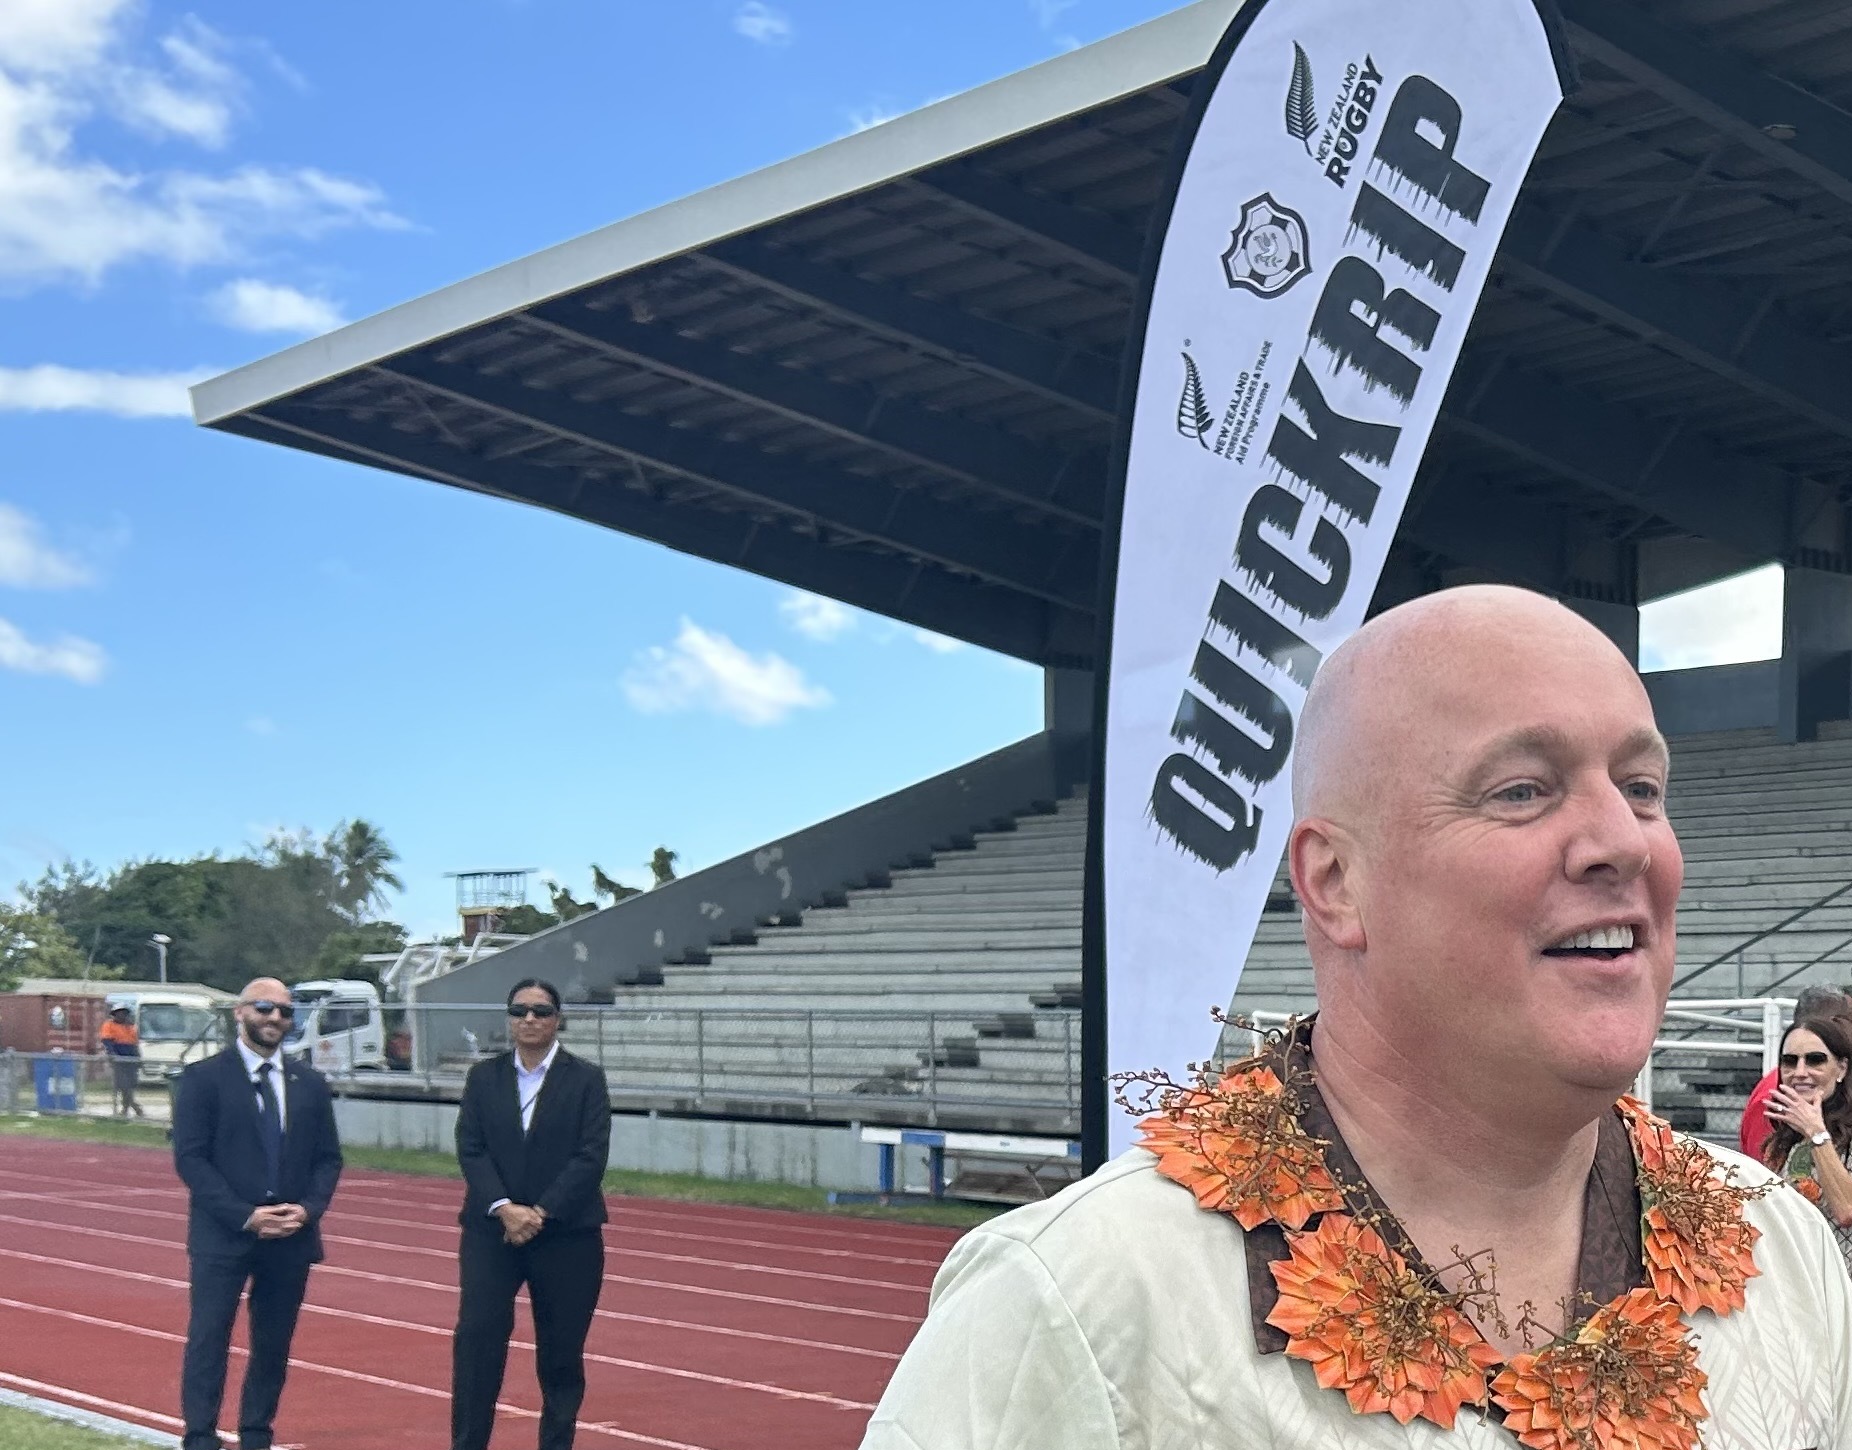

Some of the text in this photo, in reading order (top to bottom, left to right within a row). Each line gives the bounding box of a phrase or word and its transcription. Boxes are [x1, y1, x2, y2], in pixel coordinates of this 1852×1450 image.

[1315, 62, 1359, 167] NEW ZEALAND
[1324, 53, 1384, 190] RUGBY
[1213, 371, 1249, 455] NEW ZEALAND
[1224, 419, 1245, 460] FOREIGN
[1240, 380, 1258, 419] AFFAIRS
[1255, 340, 1273, 371] TRADE
[1241, 382, 1270, 445] Programme
[1145, 75, 1493, 878] QUICKRIP
